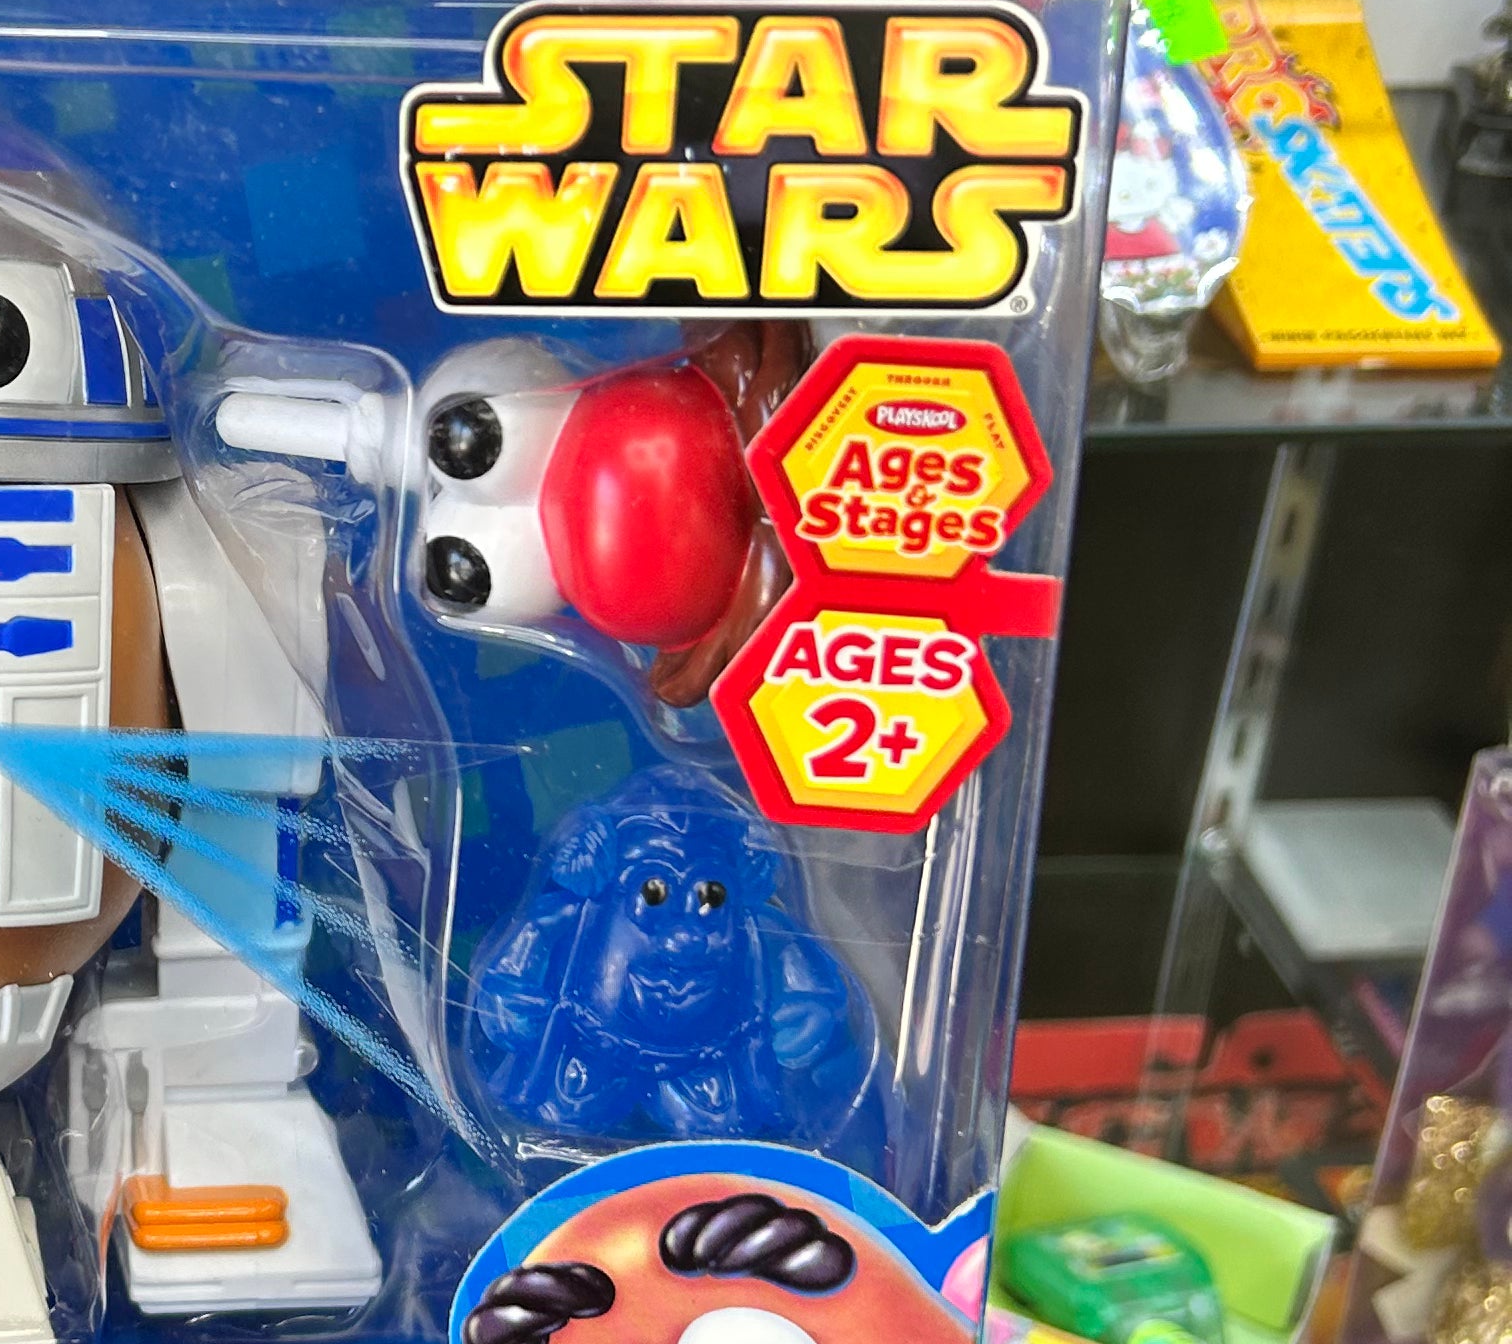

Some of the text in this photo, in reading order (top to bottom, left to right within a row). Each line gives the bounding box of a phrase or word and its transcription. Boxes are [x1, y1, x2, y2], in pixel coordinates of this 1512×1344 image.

[414, 15, 1074, 156] STAR
[414, 161, 1069, 301] WARS
[805, 387, 858, 452] DISCOVERY
[875, 404, 959, 431] PLAYSKOOL
[983, 413, 1006, 451] PLAY
[829, 440, 985, 493] Ages
[904, 484, 937, 509] &
[799, 492, 1003, 552] Stages
[771, 628, 969, 691] AGES
[808, 699, 919, 779] 2+
